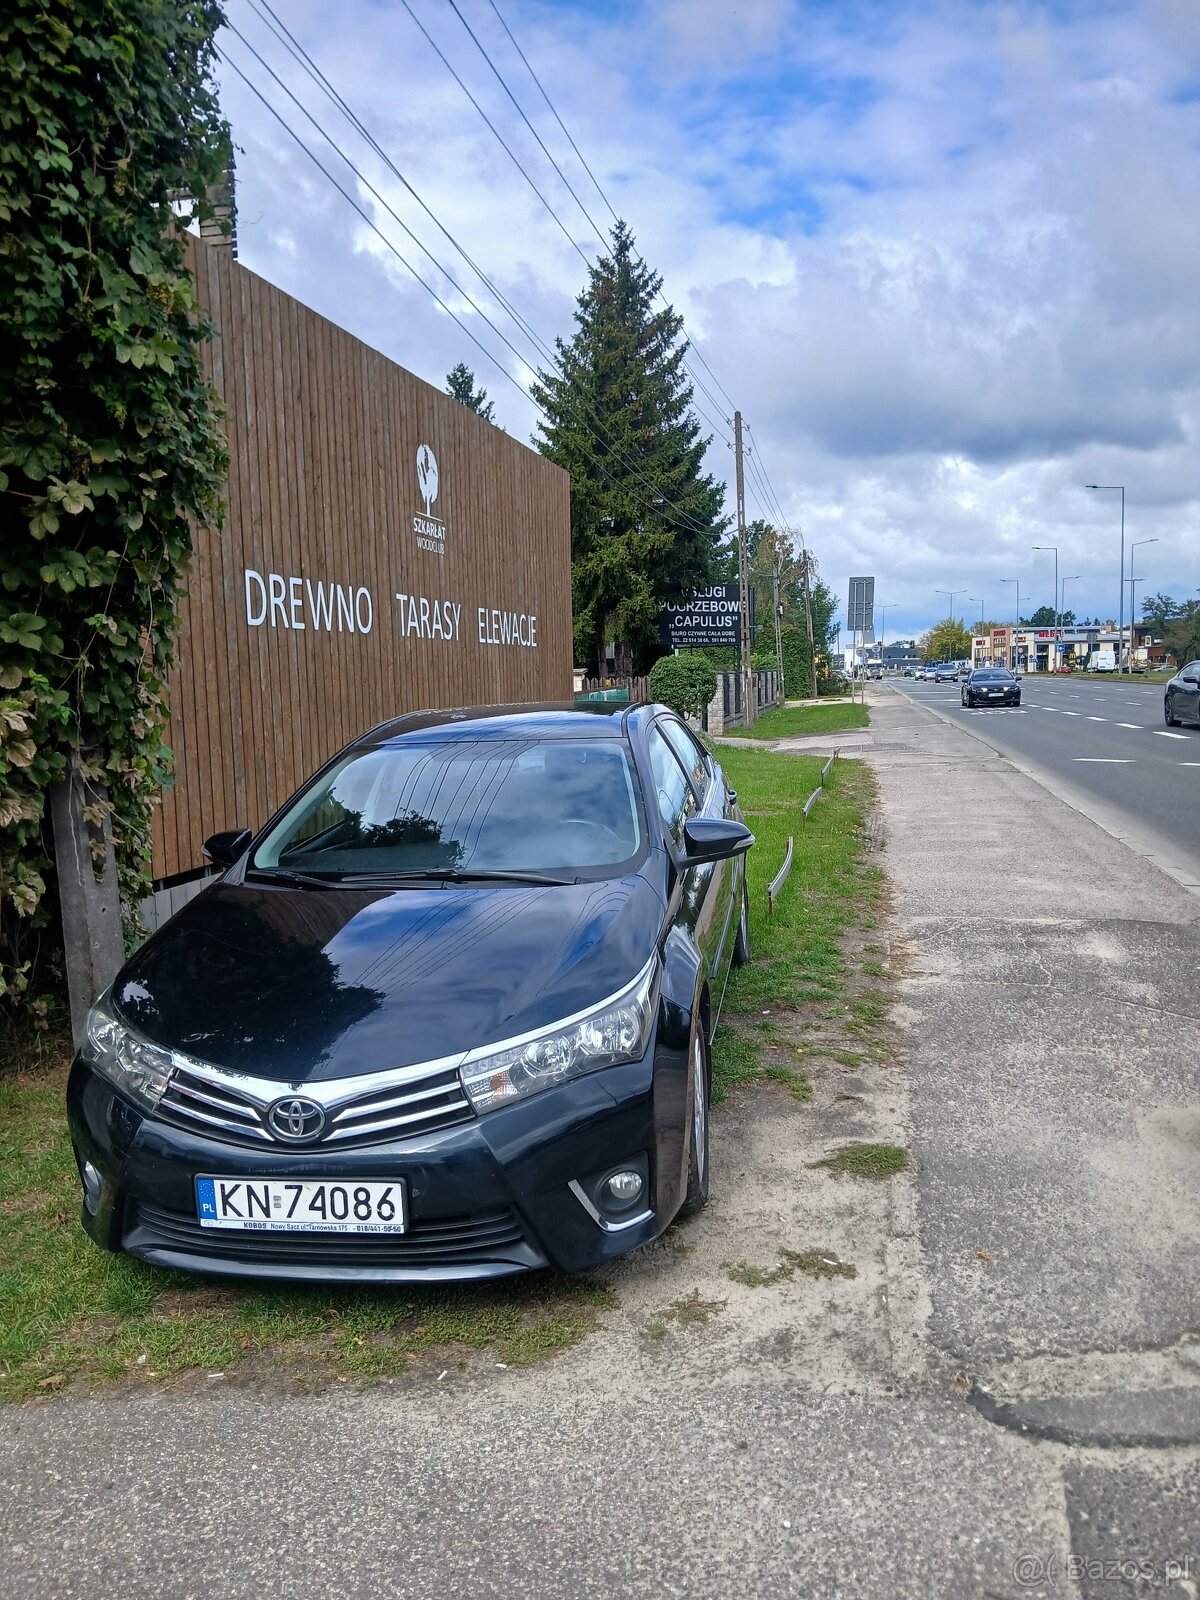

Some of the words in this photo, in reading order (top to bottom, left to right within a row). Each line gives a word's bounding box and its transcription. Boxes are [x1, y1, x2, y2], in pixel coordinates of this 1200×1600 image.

[413, 517, 446, 541] SZKARŁAT
[416, 536, 445, 555] WOODCLUB
[244, 569, 373, 634] DREWNO
[396, 593, 461, 641] TARASY
[477, 607, 538, 647] ELEWACJE
[659, 601, 742, 612] POGRZEBOW
[669, 615, 738, 629] „CAPULUS”
[1038, 630, 1065, 638] MEBE
[202, 1203, 215, 1213] PL
[220, 1183, 272, 1218] KN
[284, 1184, 396, 1222] 74086
[270, 1223, 286, 1231] Nowy
[286, 1223, 300, 1231] Sącz
[308, 1224, 337, 1232] Tarnowska
